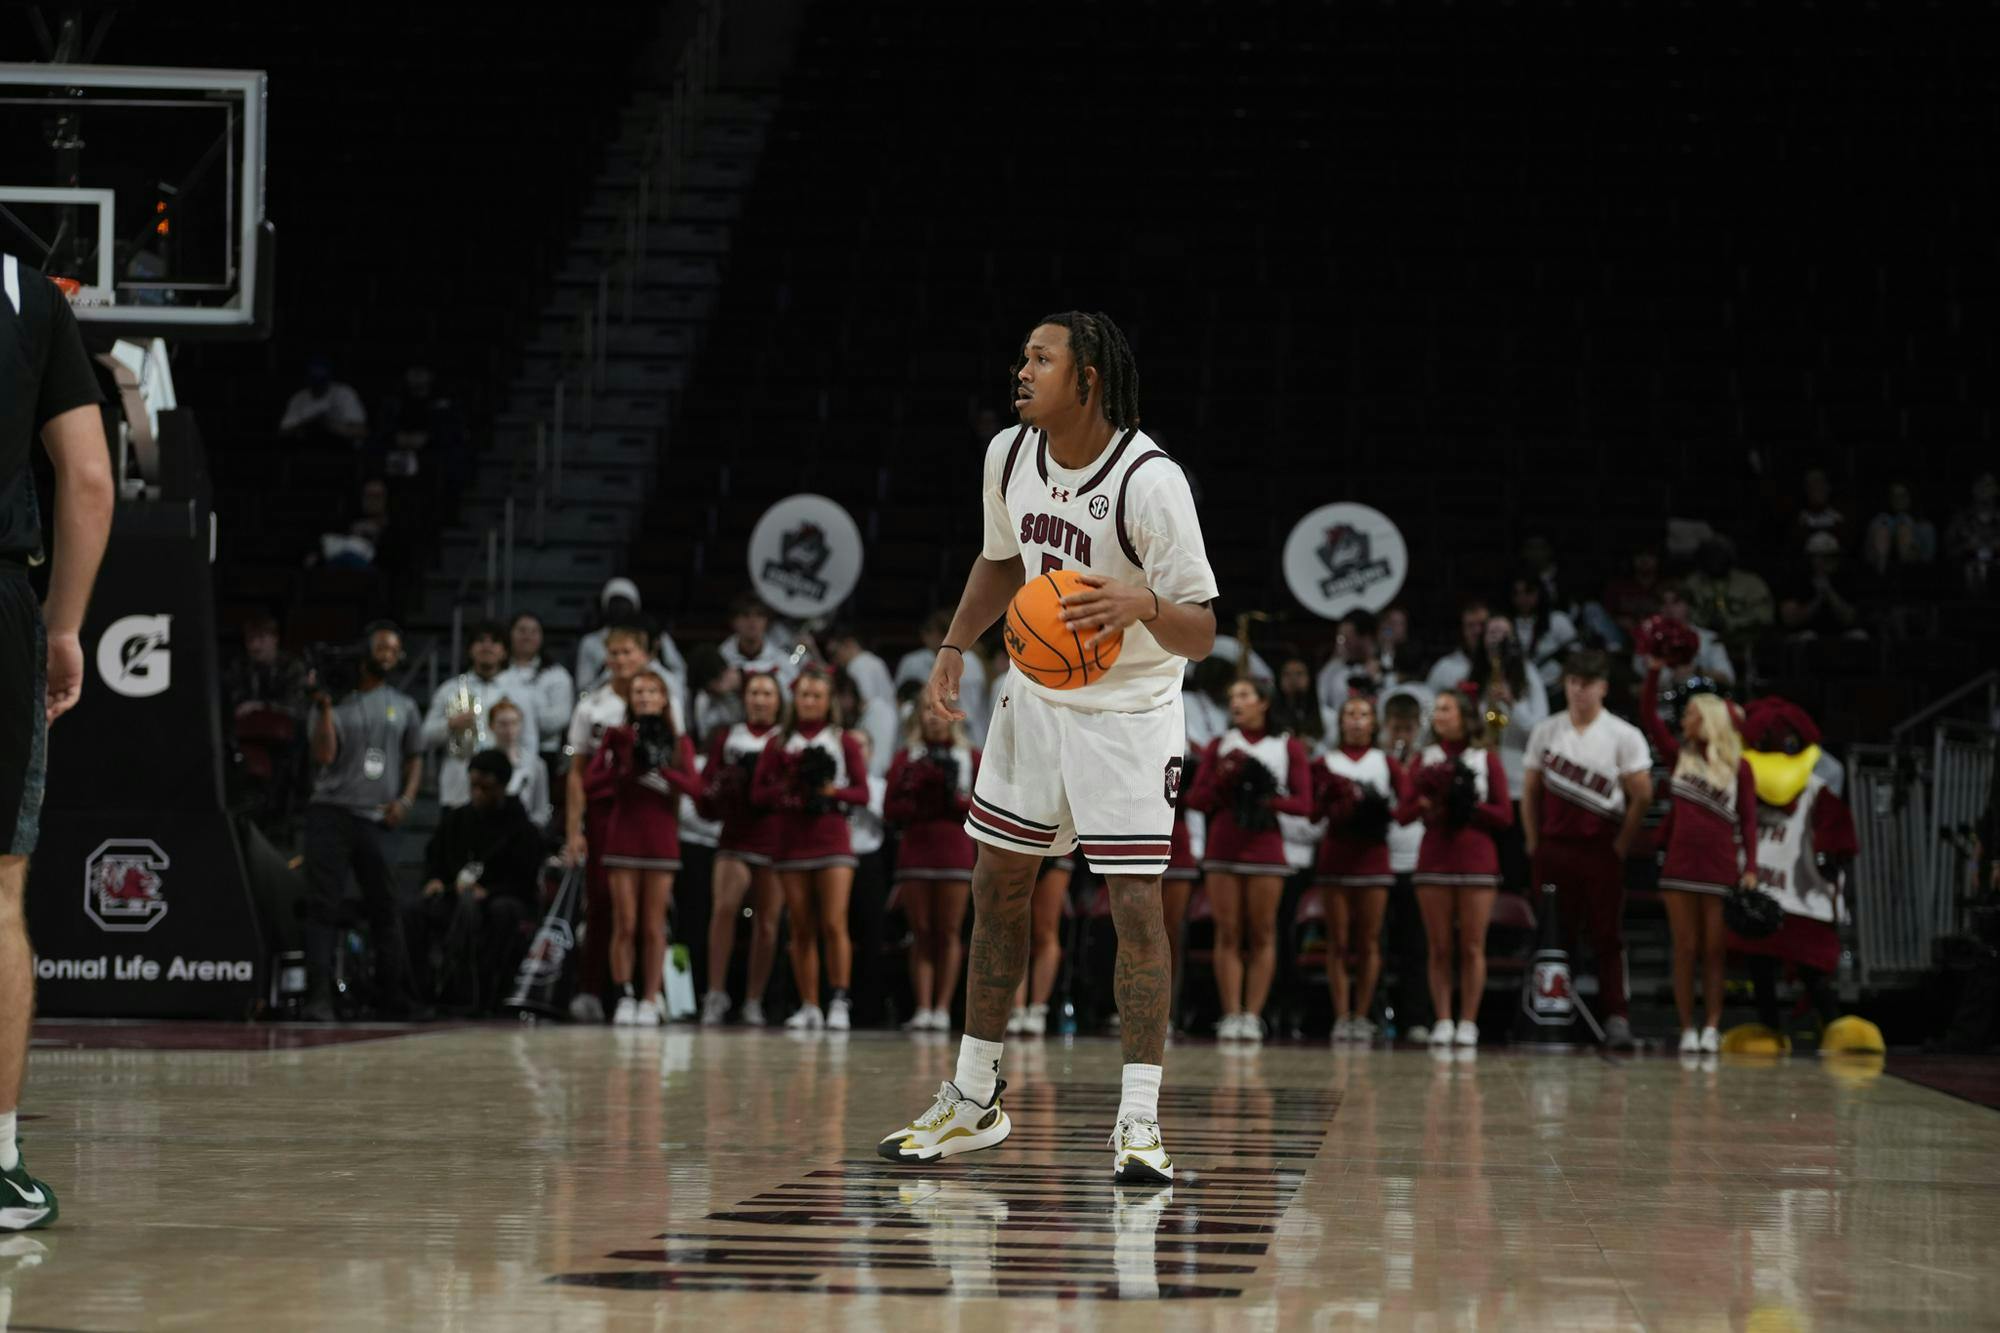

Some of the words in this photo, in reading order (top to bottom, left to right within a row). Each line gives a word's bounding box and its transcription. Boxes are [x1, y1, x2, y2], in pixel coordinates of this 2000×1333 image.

[1089, 496, 1109, 519] SEC
[1020, 513, 1092, 568] SOUTH
[97, 614, 174, 697] G
[33, 954, 107, 980] lonial
[114, 954, 161, 980] Life
[166, 955, 253, 981] Arena
